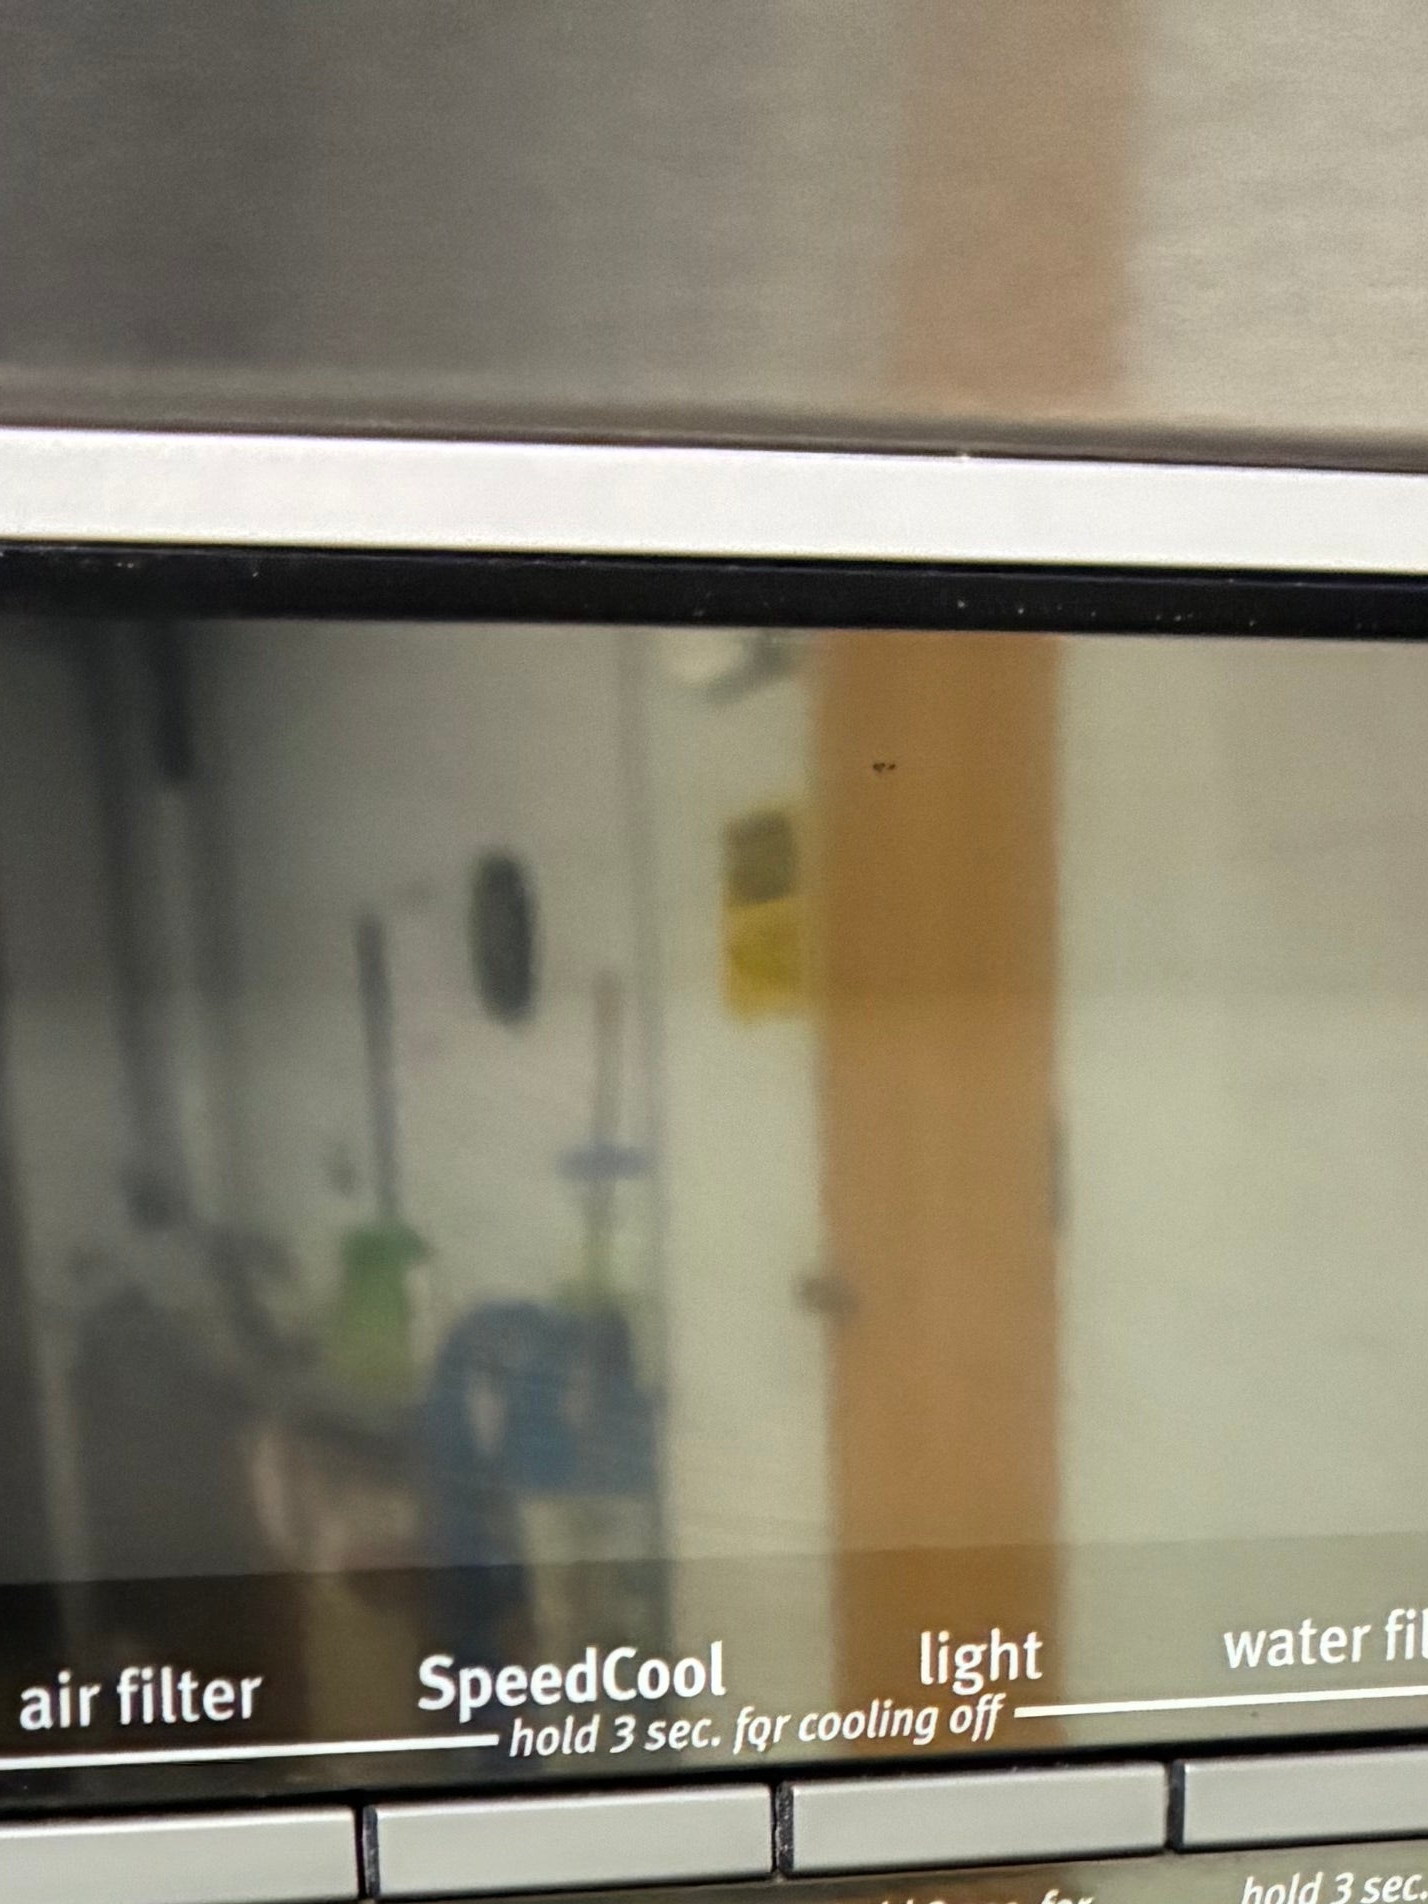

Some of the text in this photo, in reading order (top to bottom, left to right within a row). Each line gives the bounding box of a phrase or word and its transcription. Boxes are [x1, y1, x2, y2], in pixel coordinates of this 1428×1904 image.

[921, 1628, 1042, 1695] light
[1224, 1619, 1371, 1668] water
[19, 1666, 262, 1730] air filter
[418, 1641, 726, 1723] SpeedCool
[509, 1693, 1006, 1757] hold 3 sec. for cooling off
[1360, 1874, 1428, 1904] sec.
